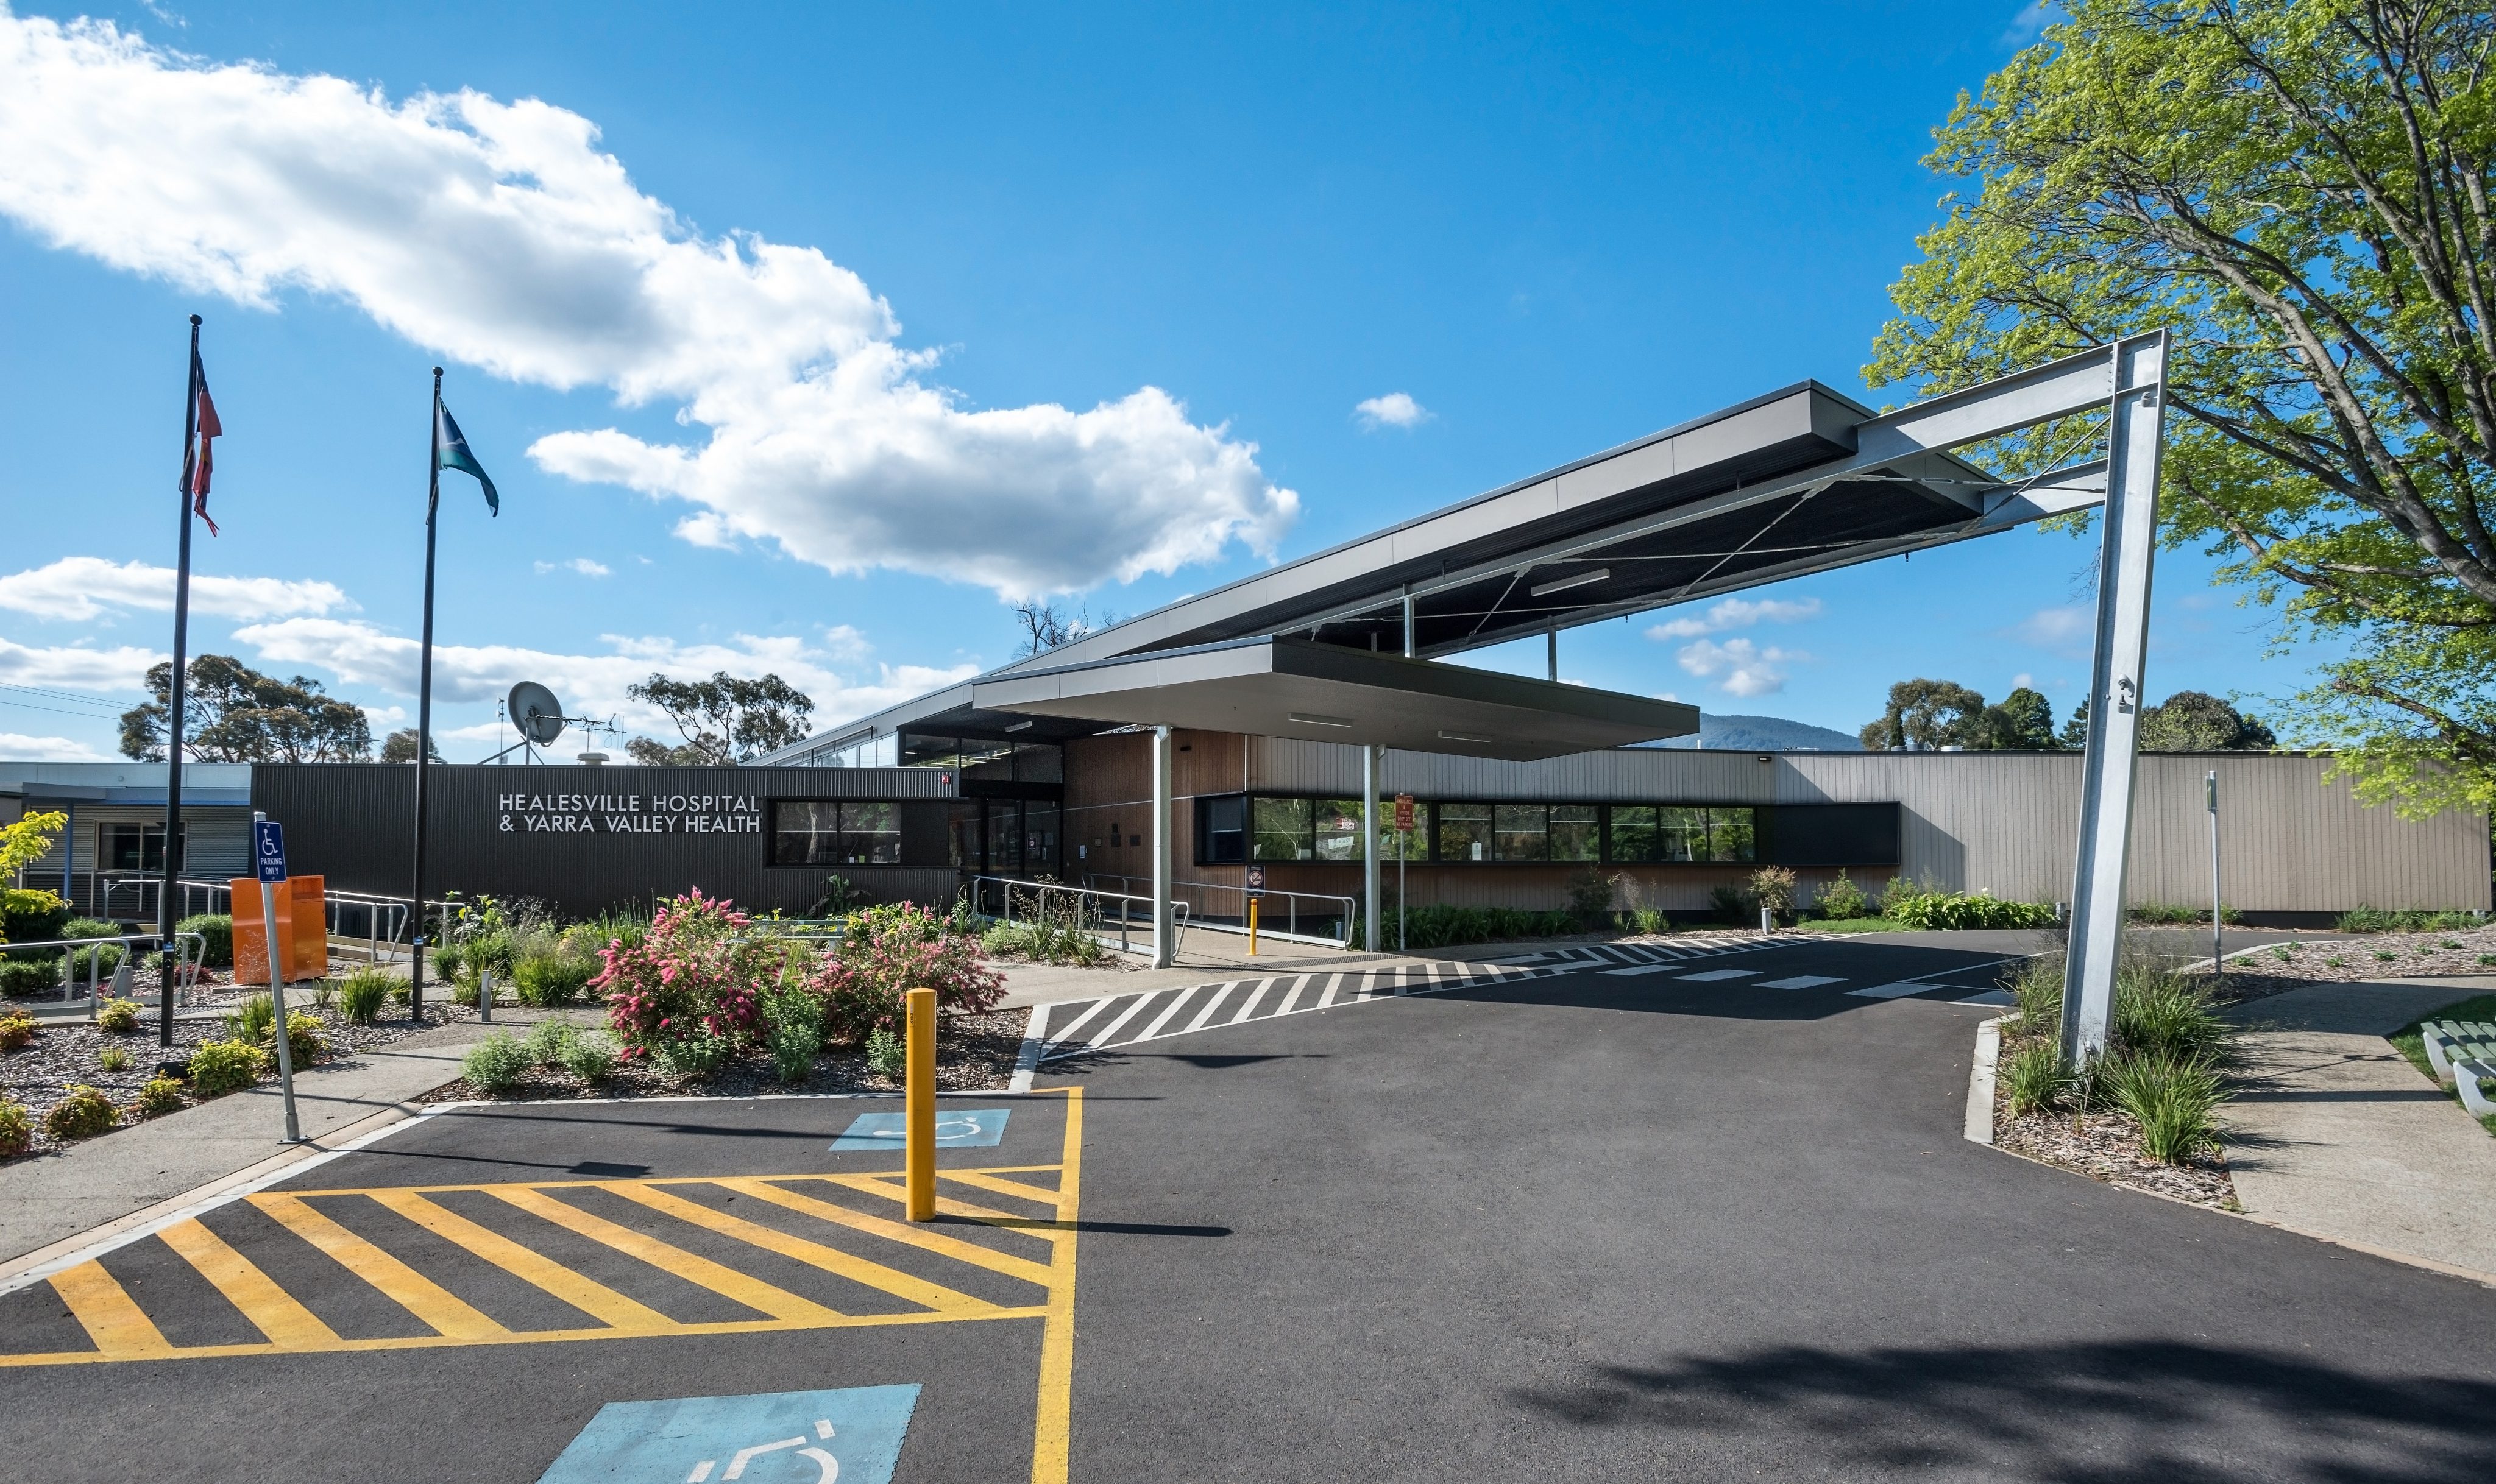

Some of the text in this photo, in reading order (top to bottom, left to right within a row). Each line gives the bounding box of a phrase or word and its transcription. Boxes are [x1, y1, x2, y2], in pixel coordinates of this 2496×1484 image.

[500, 794, 759, 812] HEALESVILLE HOSPITAL
[500, 814, 759, 833] & YARRA VALLEY HEALTH
